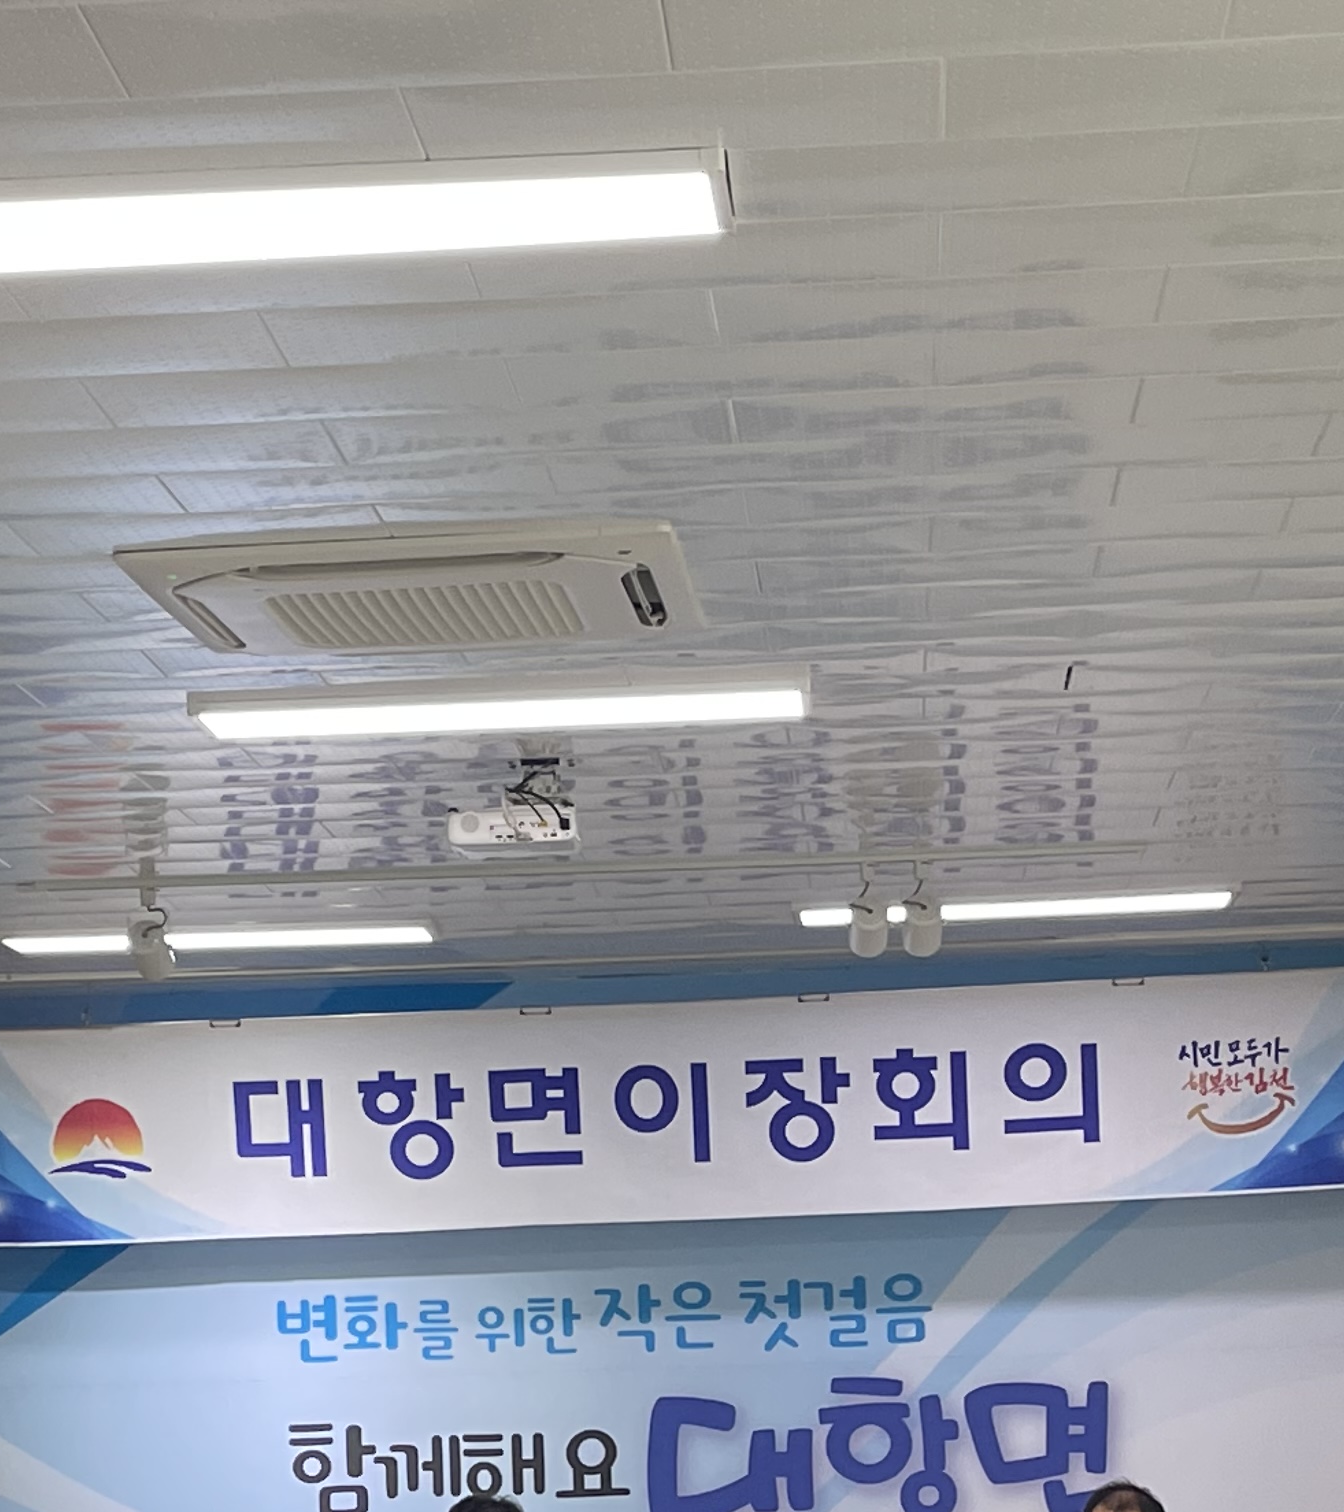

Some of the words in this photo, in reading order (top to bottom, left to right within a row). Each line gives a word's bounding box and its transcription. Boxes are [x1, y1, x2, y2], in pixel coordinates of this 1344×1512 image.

[1178, 1040, 1222, 1067] 시민
[1227, 1036, 1290, 1067] 모두가
[1181, 1068, 1243, 1096] 행복한
[1244, 1067, 1295, 1094] 김천
[233, 1043, 1100, 1180] 대항면이장회의
[276, 1295, 459, 1363] 변화를
[475, 1297, 582, 1354] 위한
[594, 1282, 722, 1353] 작은
[739, 1272, 932, 1353] 첫걸음
